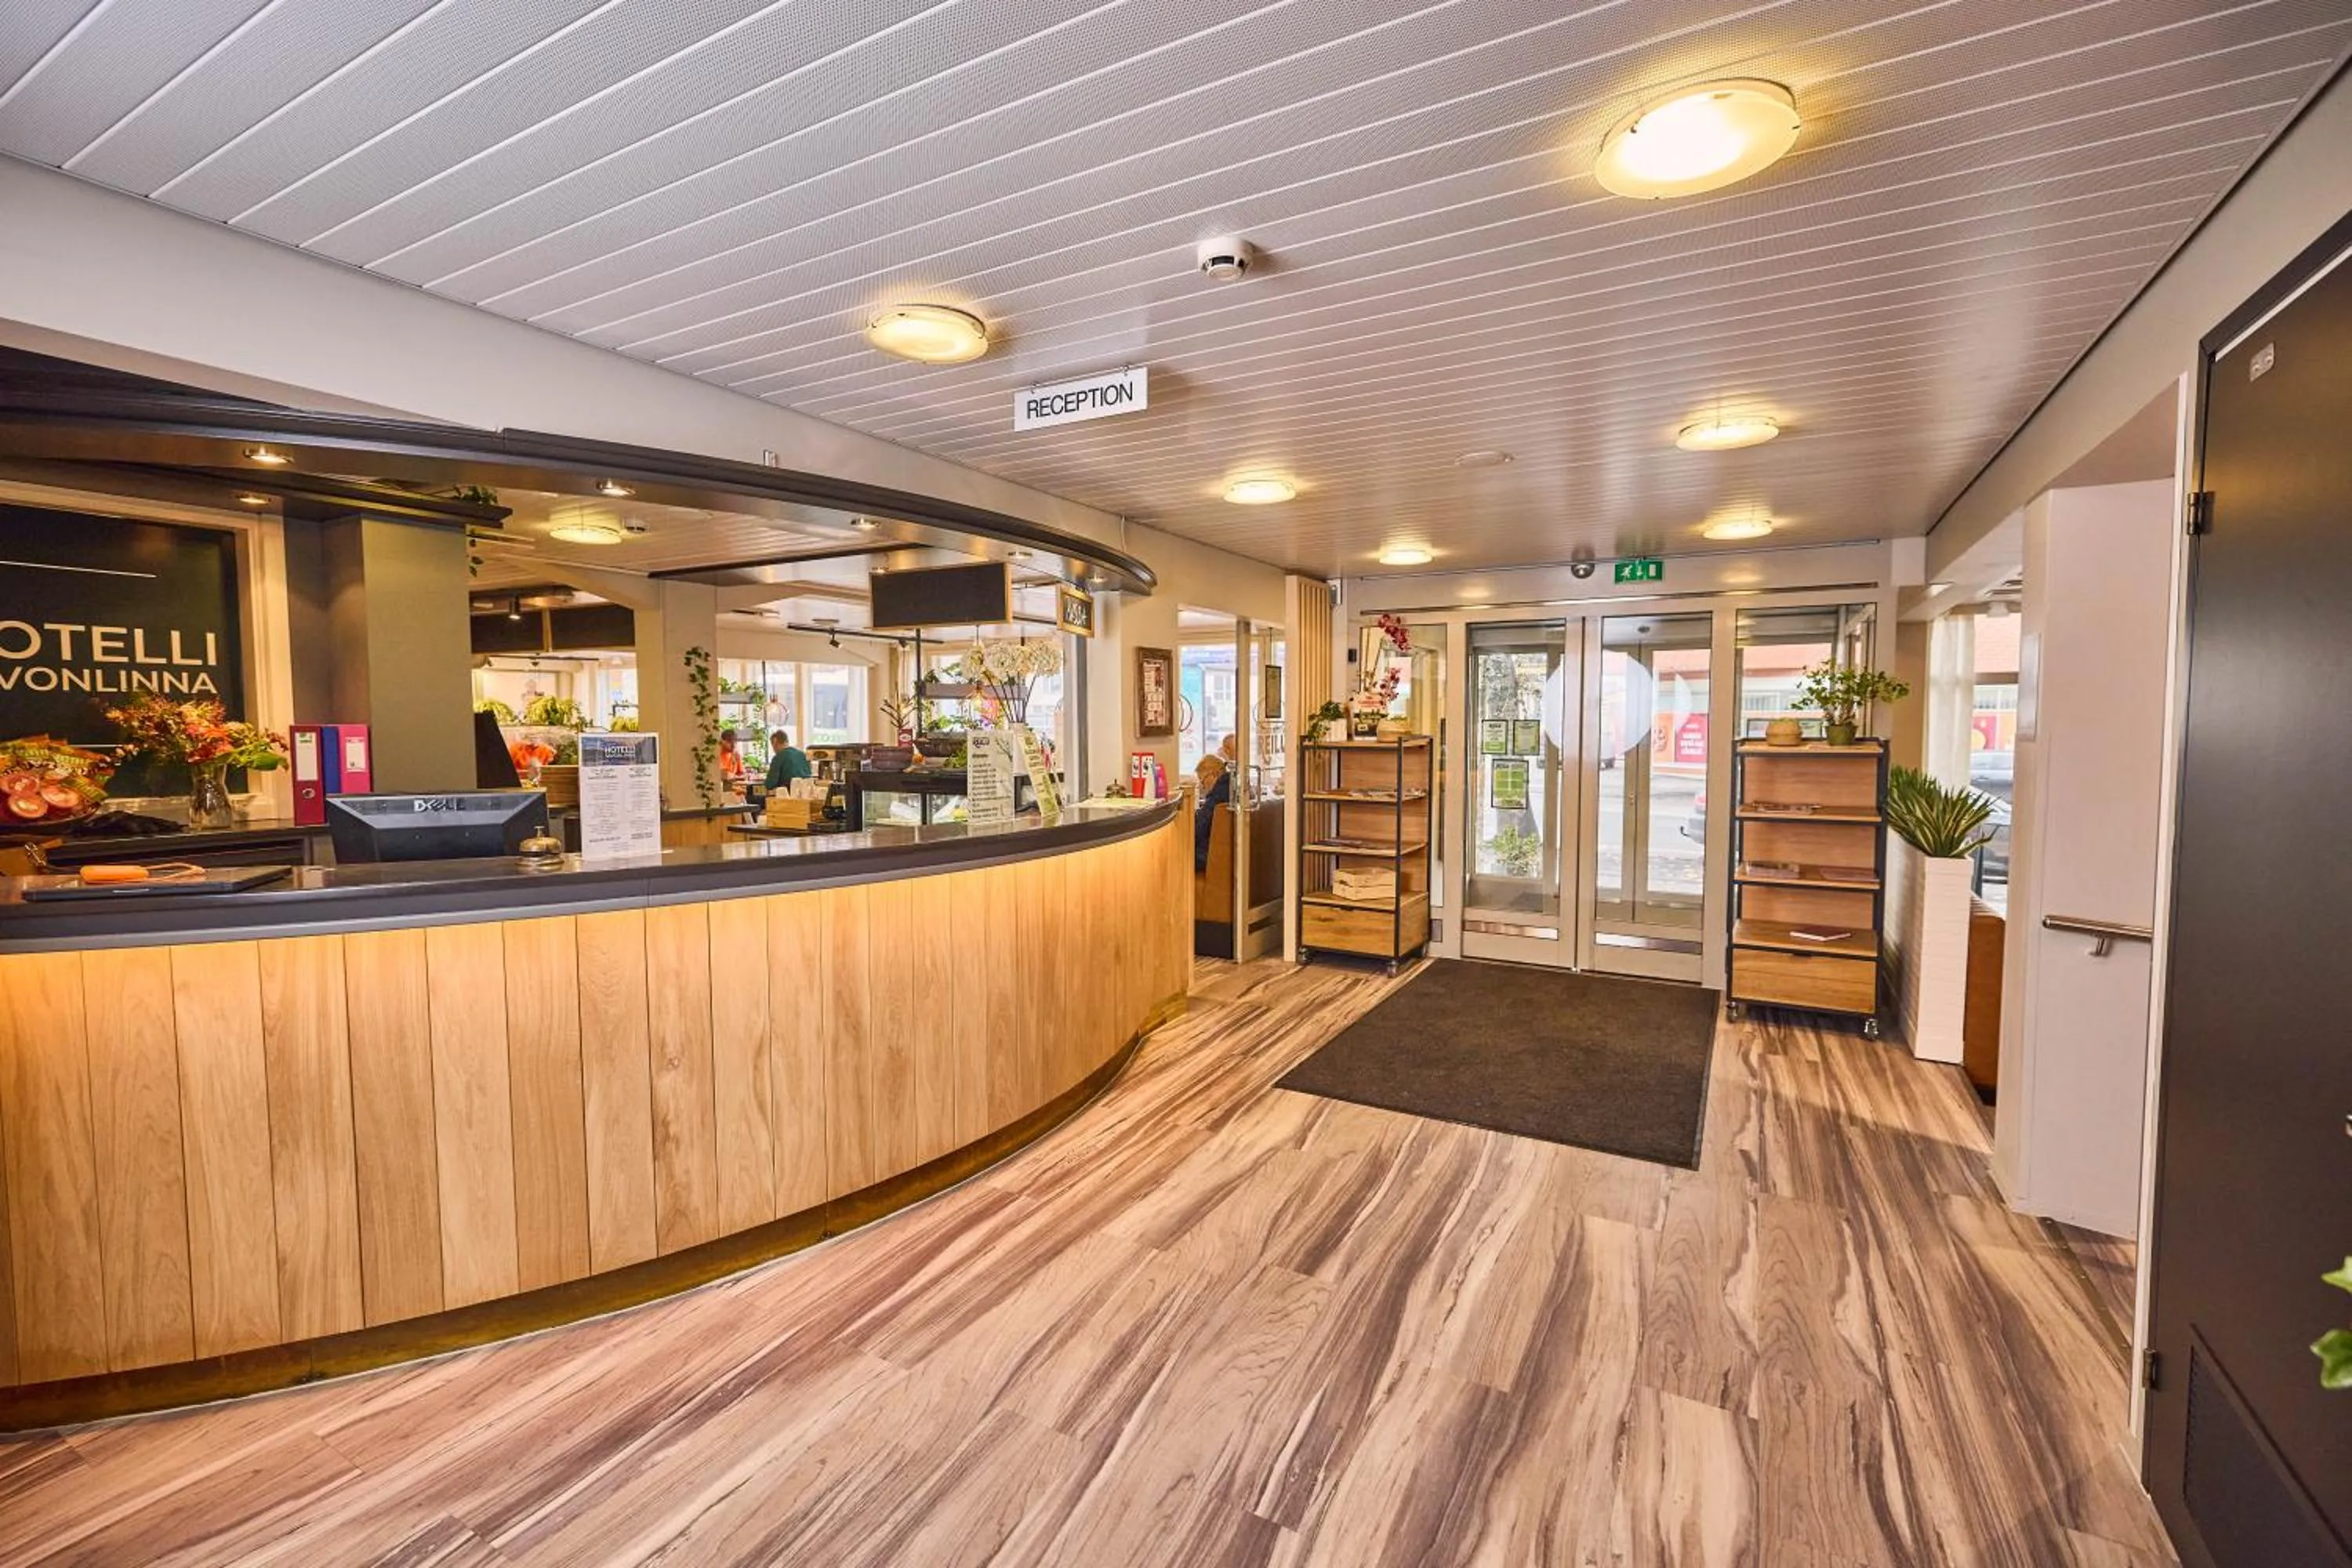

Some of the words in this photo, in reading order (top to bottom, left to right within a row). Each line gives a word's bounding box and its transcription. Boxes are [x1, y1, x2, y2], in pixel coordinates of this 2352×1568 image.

[1027, 381, 1133, 419] RECEPTION
[0, 620, 217, 666] OTELLI
[414, 798, 464, 812] DELL
